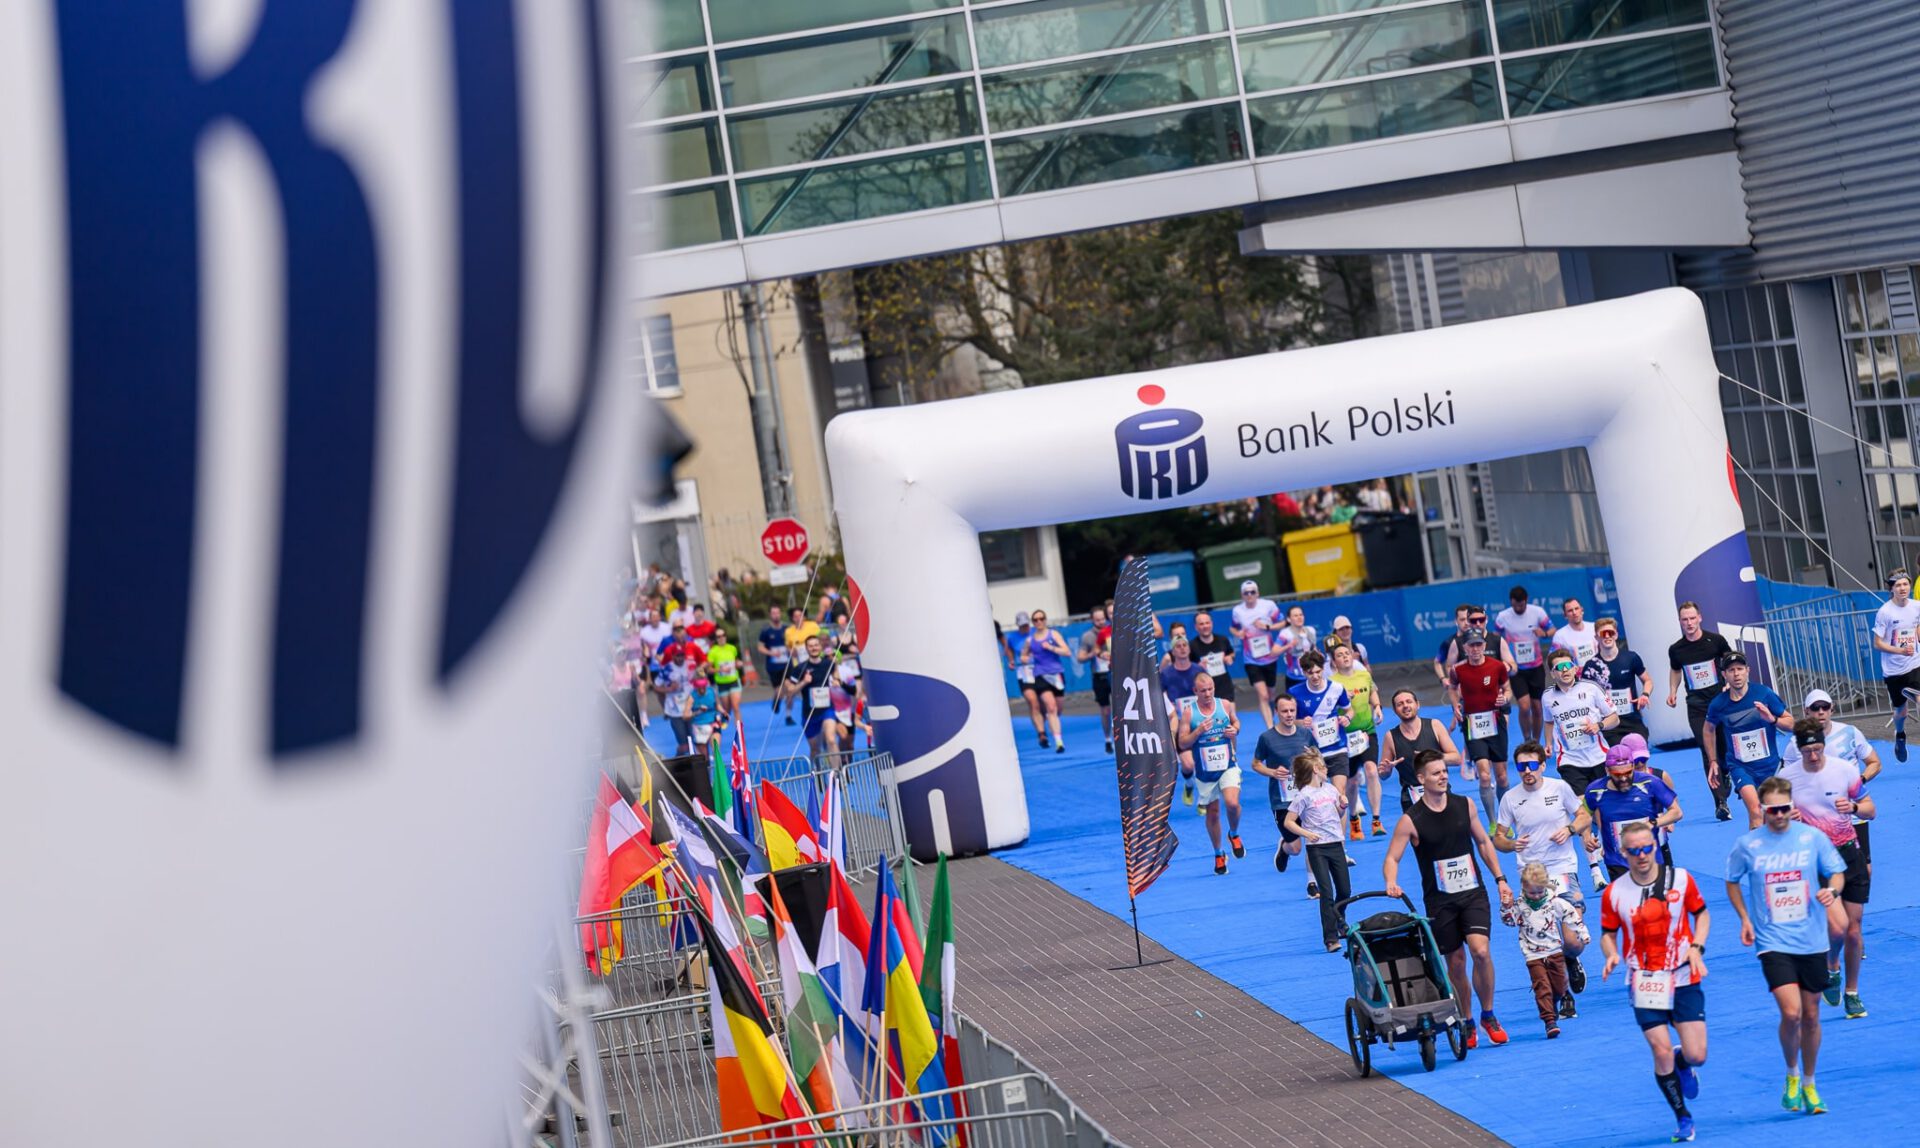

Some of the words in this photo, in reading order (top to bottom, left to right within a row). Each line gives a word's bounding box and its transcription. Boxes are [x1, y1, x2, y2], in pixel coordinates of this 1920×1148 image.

[1238, 411, 1333, 458] Bank
[1348, 390, 1456, 441] Polski
[763, 533, 806, 554] STOP
[1696, 671, 1709, 680] 255
[1122, 676, 1154, 720] 21
[1318, 727, 1336, 738] 5525
[1123, 724, 1163, 755] km
[1746, 741, 1757, 751] 99
[1208, 752, 1225, 762] 3437
[1754, 850, 1811, 871] FAME
[1447, 867, 1468, 881] 7799
[1766, 871, 1801, 884] Betclic
[1774, 896, 1802, 908] 6956
[1639, 982, 1665, 993] 6832
